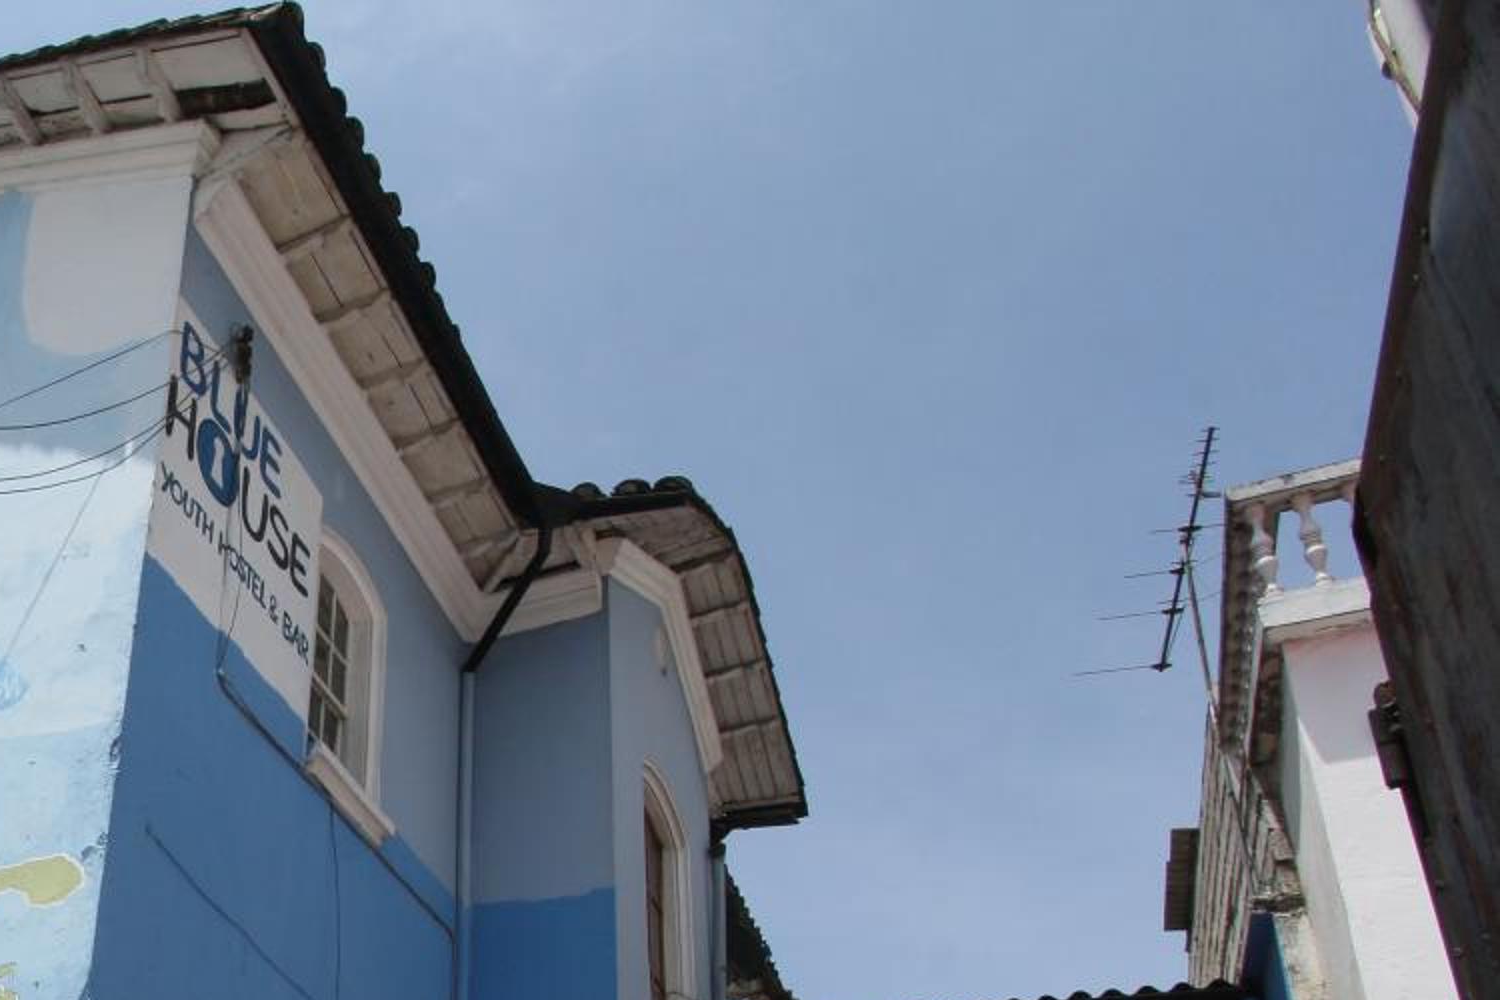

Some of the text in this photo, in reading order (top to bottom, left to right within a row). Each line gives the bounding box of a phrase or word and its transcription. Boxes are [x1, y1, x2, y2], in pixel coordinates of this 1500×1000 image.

[165, 374, 311, 598] HOUSE
[181, 321, 282, 498] BLUE
[161, 460, 309, 665] YOUTH HOSTEL & BAR
